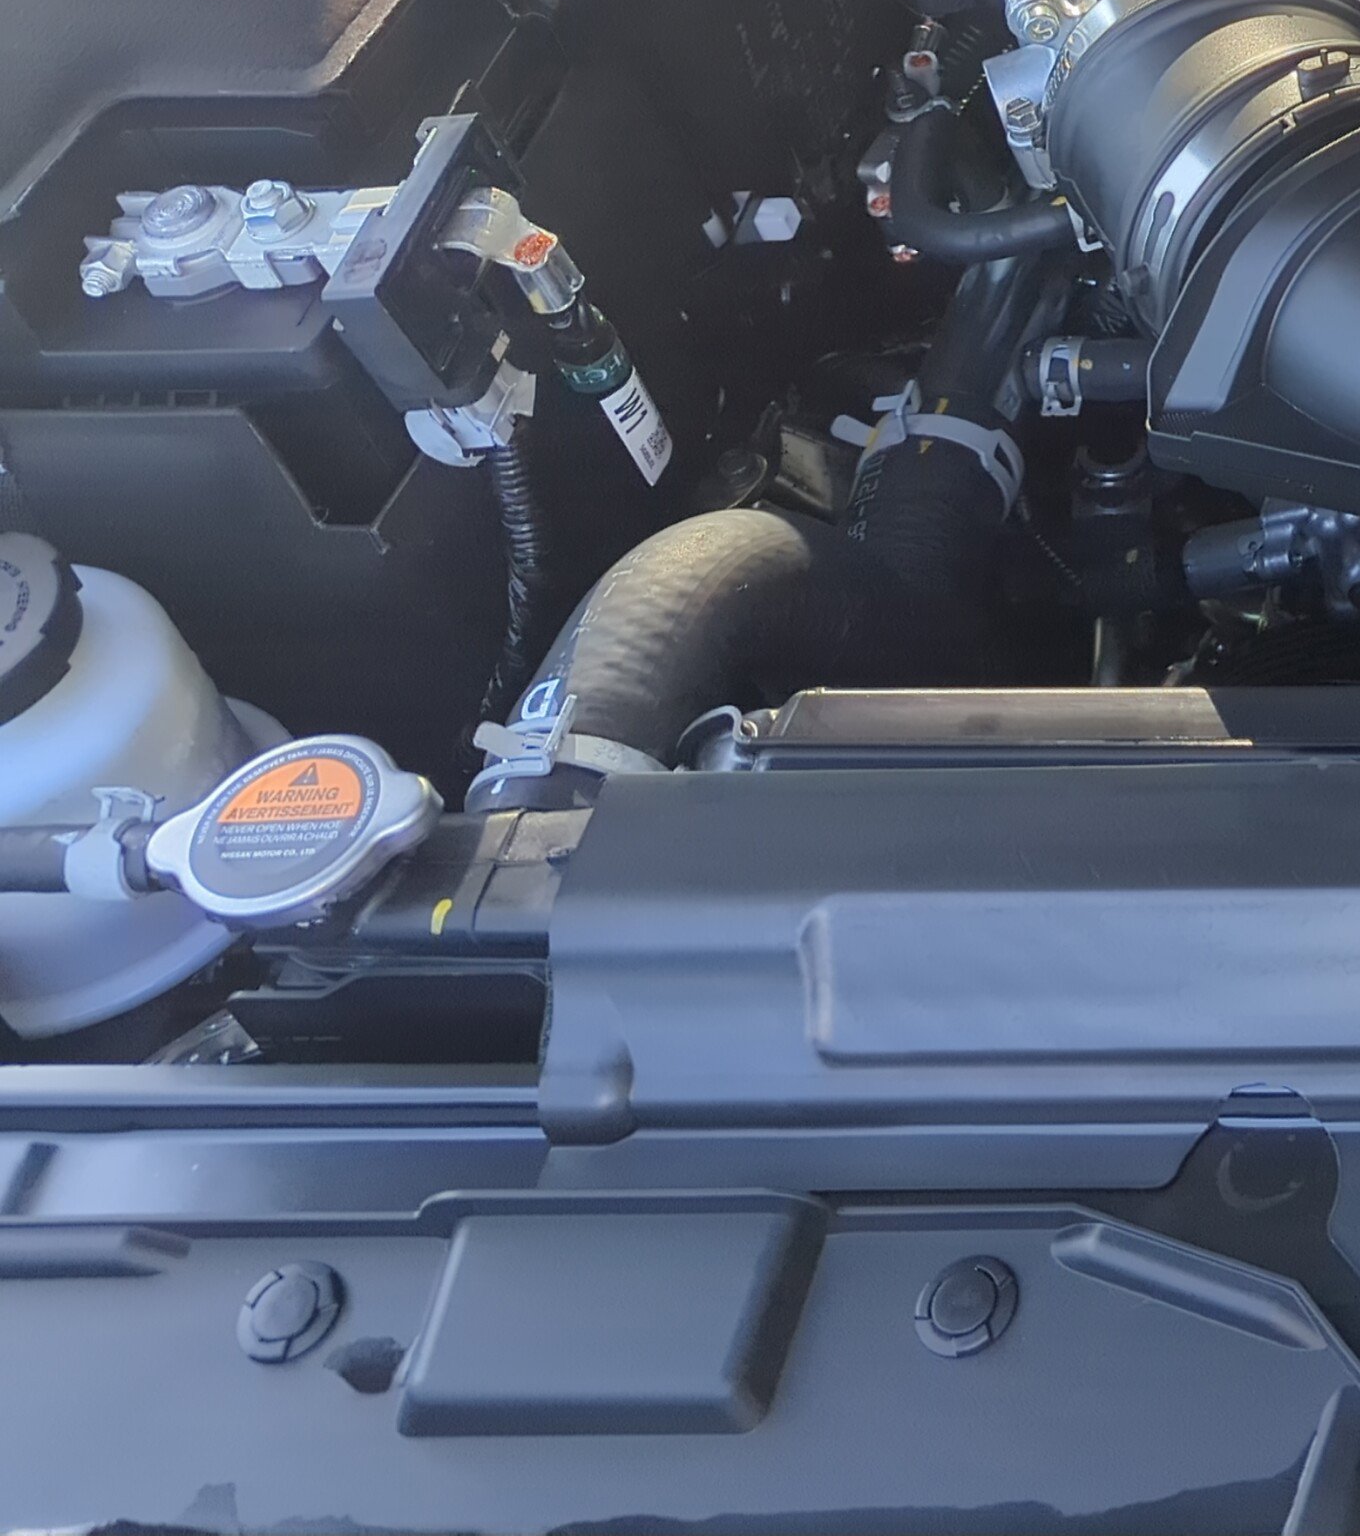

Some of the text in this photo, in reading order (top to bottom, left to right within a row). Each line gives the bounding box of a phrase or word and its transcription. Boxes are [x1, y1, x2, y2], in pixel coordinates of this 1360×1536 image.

[614, 387, 648, 434] W1
[257, 787, 340, 803] WARNING
[226, 803, 354, 819] AVERTISSEMENT
[254, 850, 282, 858] MOTOR
